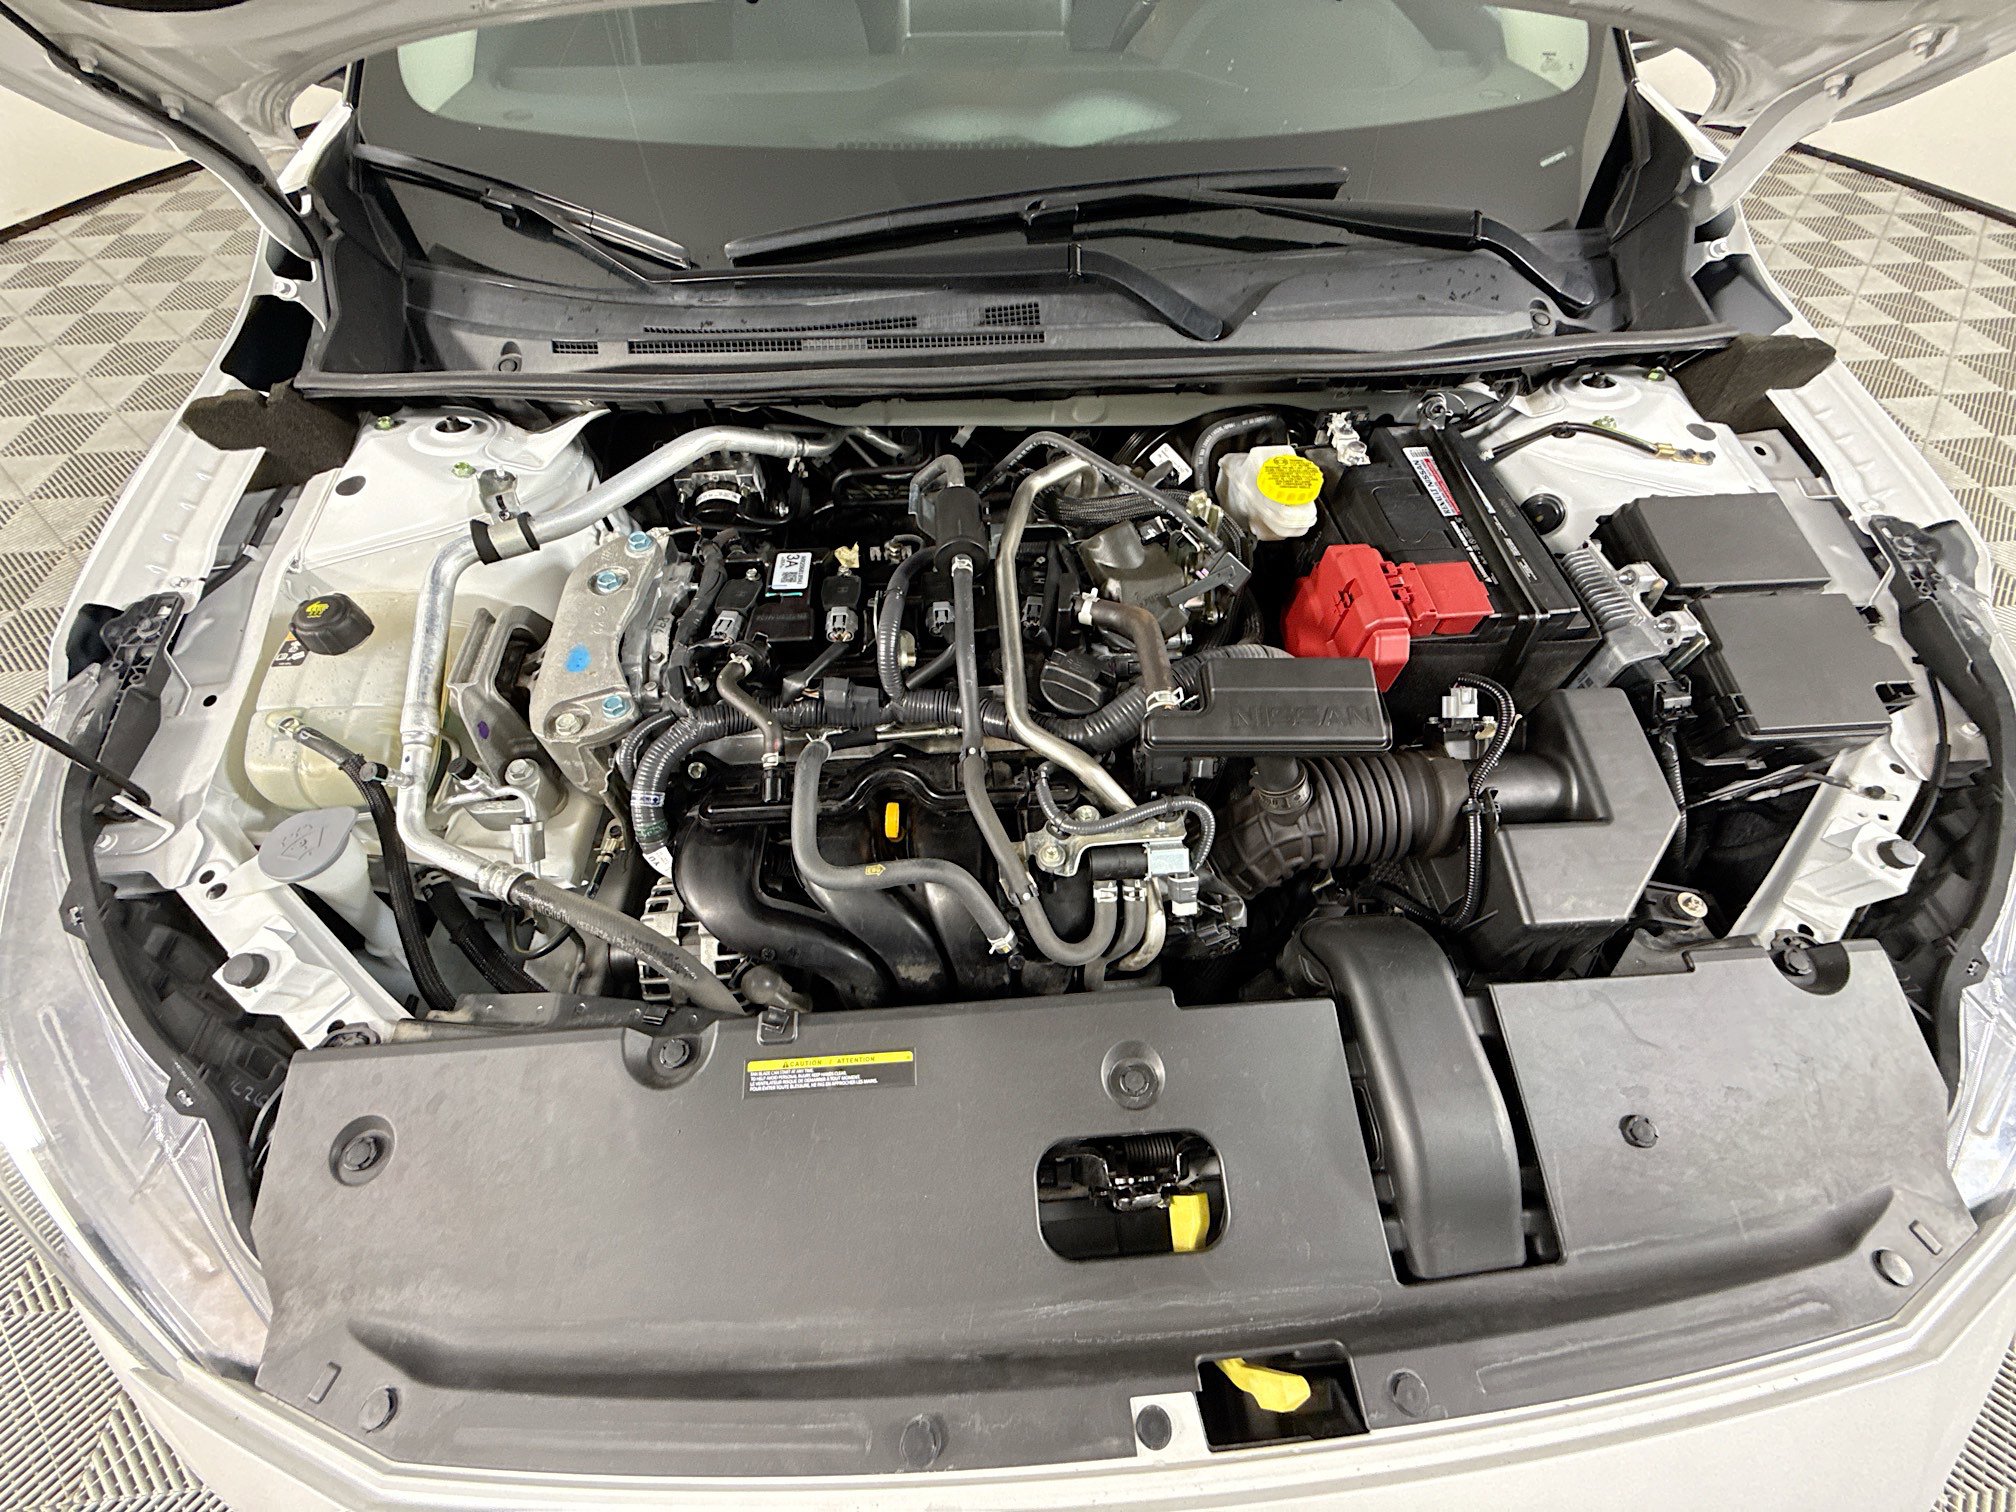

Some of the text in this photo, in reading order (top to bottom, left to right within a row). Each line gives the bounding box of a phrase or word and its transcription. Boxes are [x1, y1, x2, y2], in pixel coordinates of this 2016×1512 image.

[785, 554, 800, 568] 3A
[1229, 705, 1376, 728] NISSAN
[790, 1059, 822, 1067] CAUTION
[837, 1056, 875, 1065] ATTENTION
